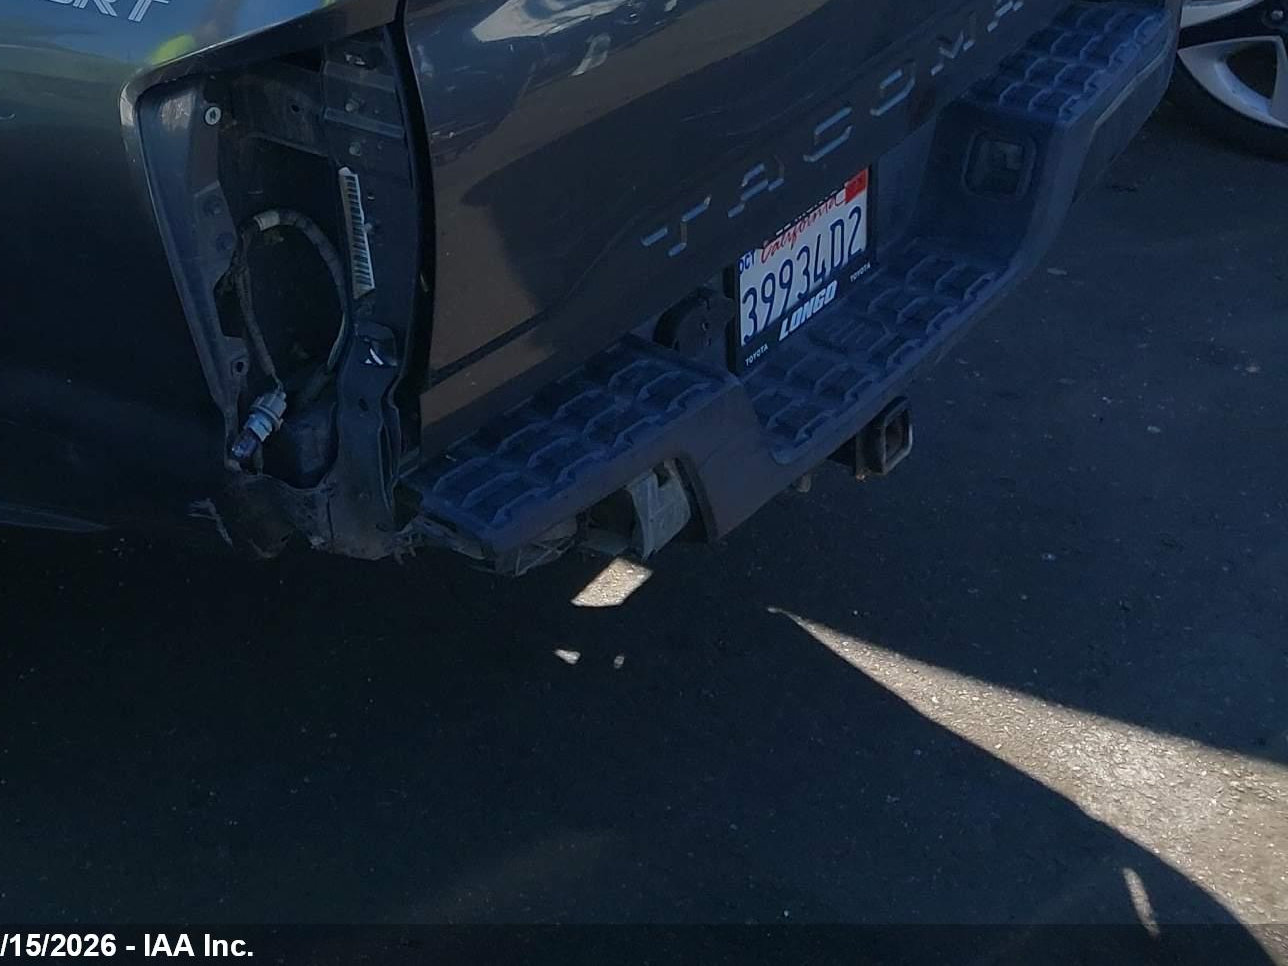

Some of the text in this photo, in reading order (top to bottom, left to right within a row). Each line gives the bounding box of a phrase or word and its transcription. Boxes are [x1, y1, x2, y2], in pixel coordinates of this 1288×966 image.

[741, 205, 863, 345] 39934D2
[849, 261, 872, 283] TOYOTA
[778, 279, 839, 342] LONGO
[744, 343, 769, 366] TOYOTA
